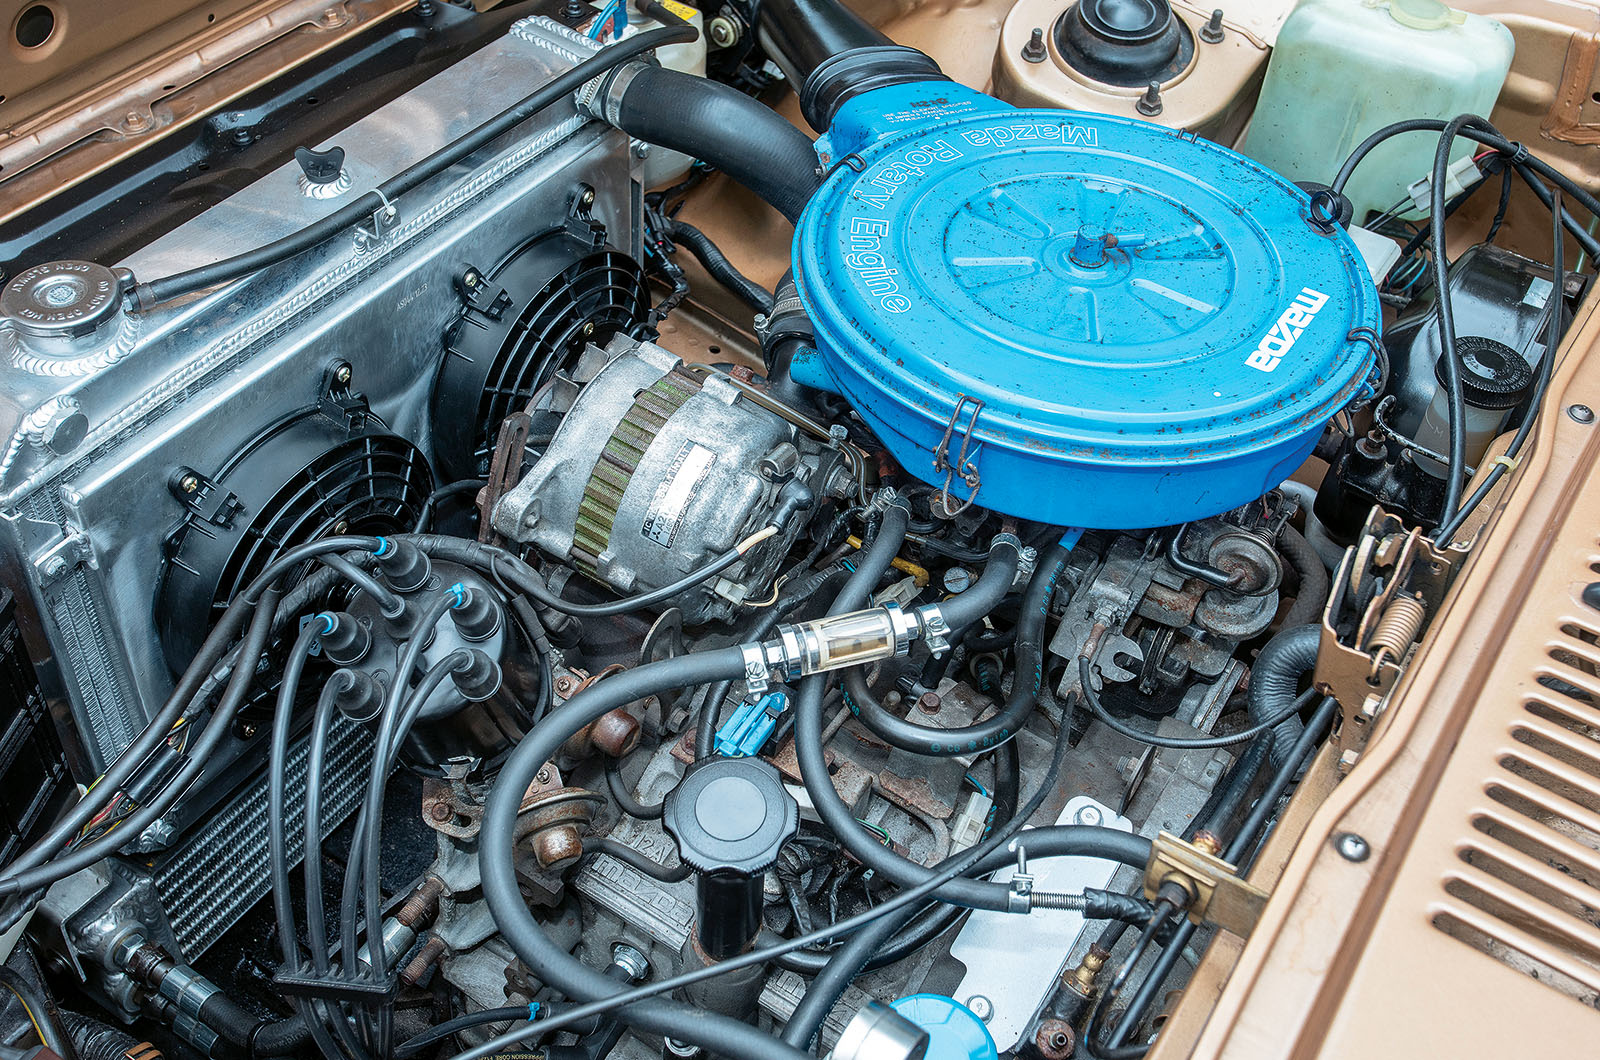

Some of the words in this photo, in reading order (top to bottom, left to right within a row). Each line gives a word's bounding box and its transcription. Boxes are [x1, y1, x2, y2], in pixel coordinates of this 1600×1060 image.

[961, 124, 1098, 147] Mazda
[853, 140, 963, 209] Rotary
[55, 263, 90, 272] OPEN
[846, 217, 911, 313] Engine
[11, 266, 51, 293] SLOWLY
[98, 280, 109, 292] DO
[87, 294, 106, 310] NOT
[19, 308, 44, 320] HOT
[46, 309, 83, 321] OPEN
[1244, 286, 1331, 373] mazda
